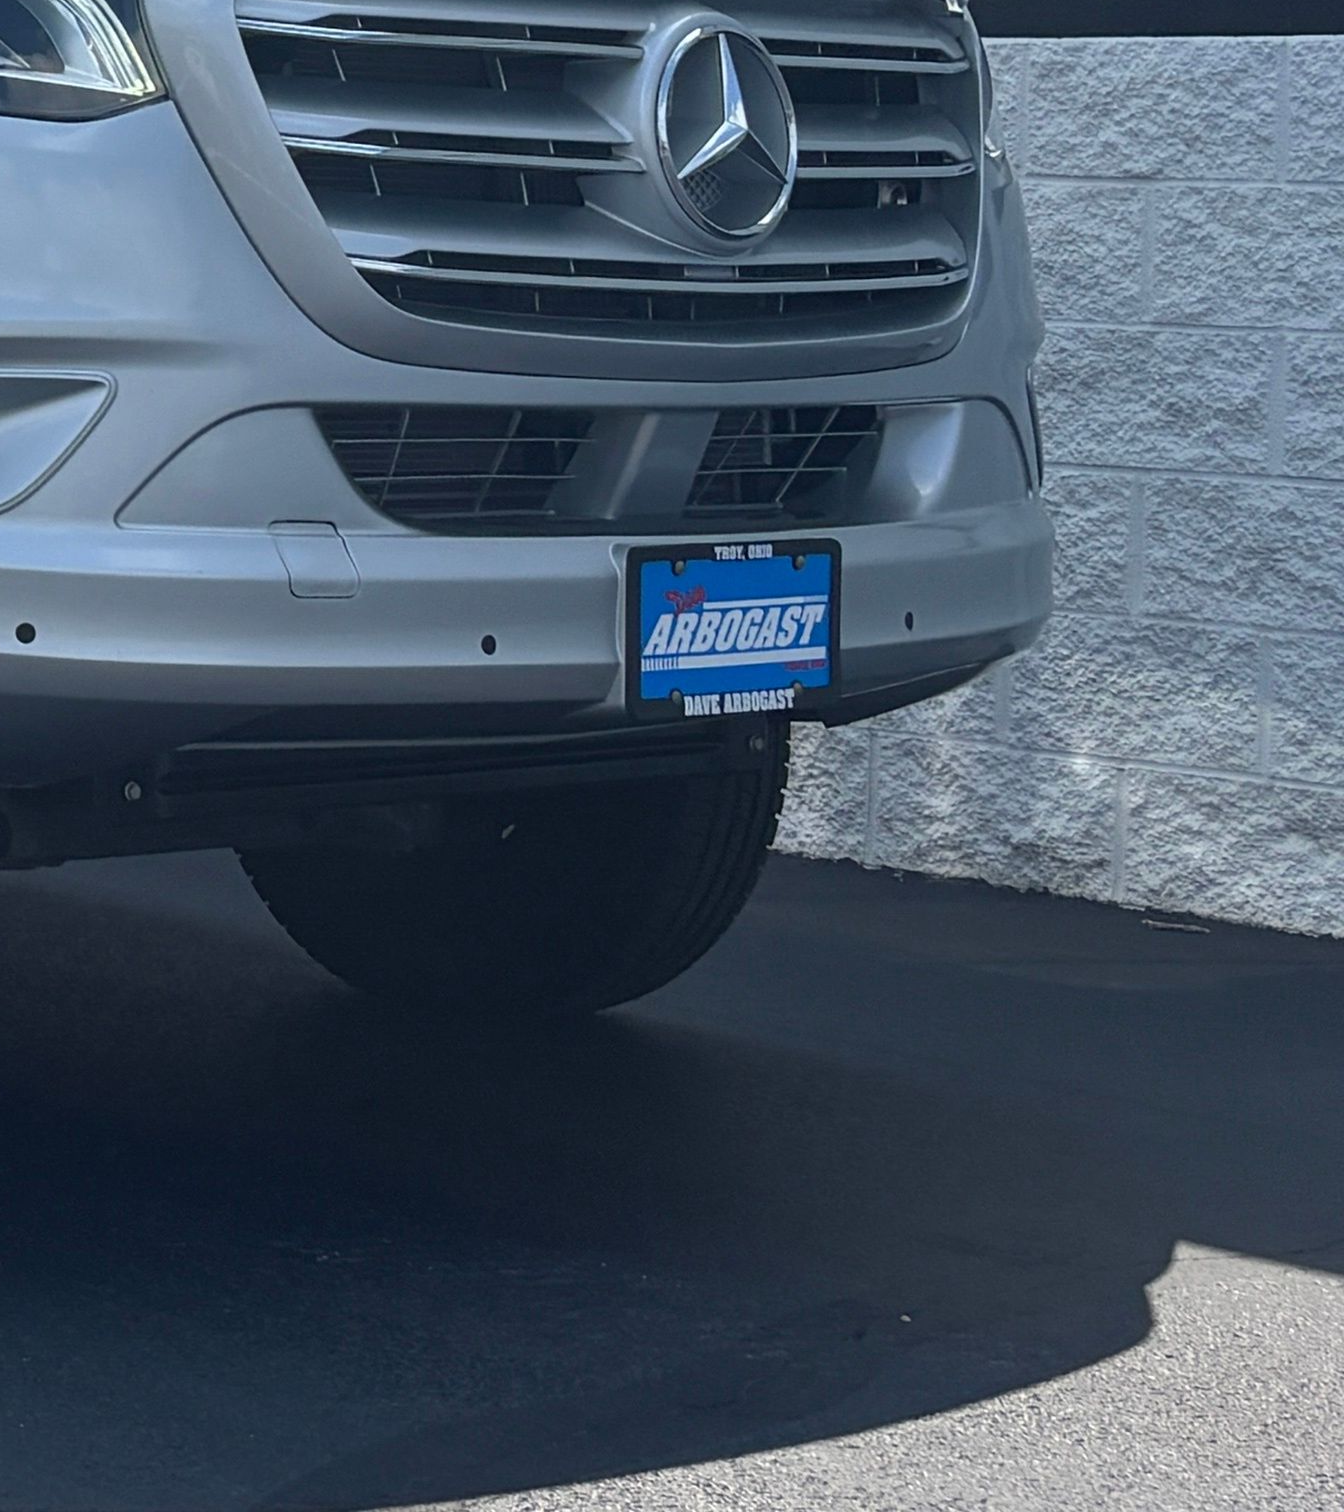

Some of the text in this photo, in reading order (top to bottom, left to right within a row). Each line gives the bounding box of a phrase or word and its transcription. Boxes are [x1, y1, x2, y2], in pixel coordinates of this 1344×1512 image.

[714, 543, 773, 561] TROY, OHIO
[642, 603, 826, 656] ARBOGAST
[683, 688, 795, 717] DAVE ARBOGAST
